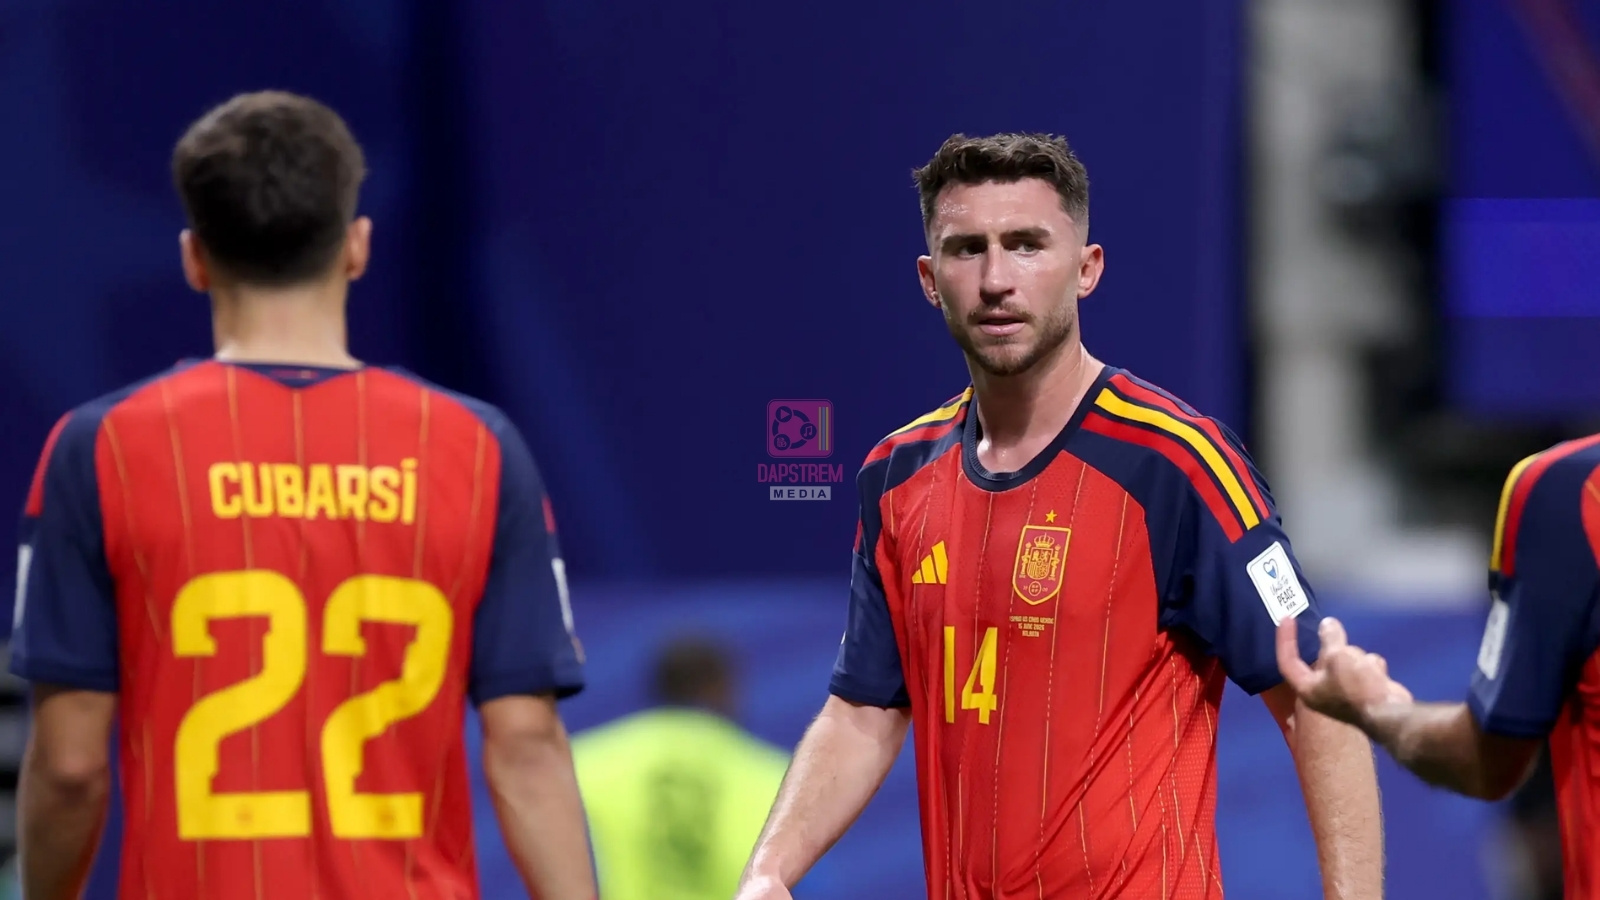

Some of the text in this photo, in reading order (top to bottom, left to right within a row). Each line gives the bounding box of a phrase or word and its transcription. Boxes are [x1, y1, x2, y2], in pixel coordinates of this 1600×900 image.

[208, 458, 418, 525] CUBARSÍ
[1276, 586, 1296, 606] PEACE
[1286, 601, 1296, 611] FIFA
[171, 569, 454, 841] 22
[944, 626, 998, 725] 14
